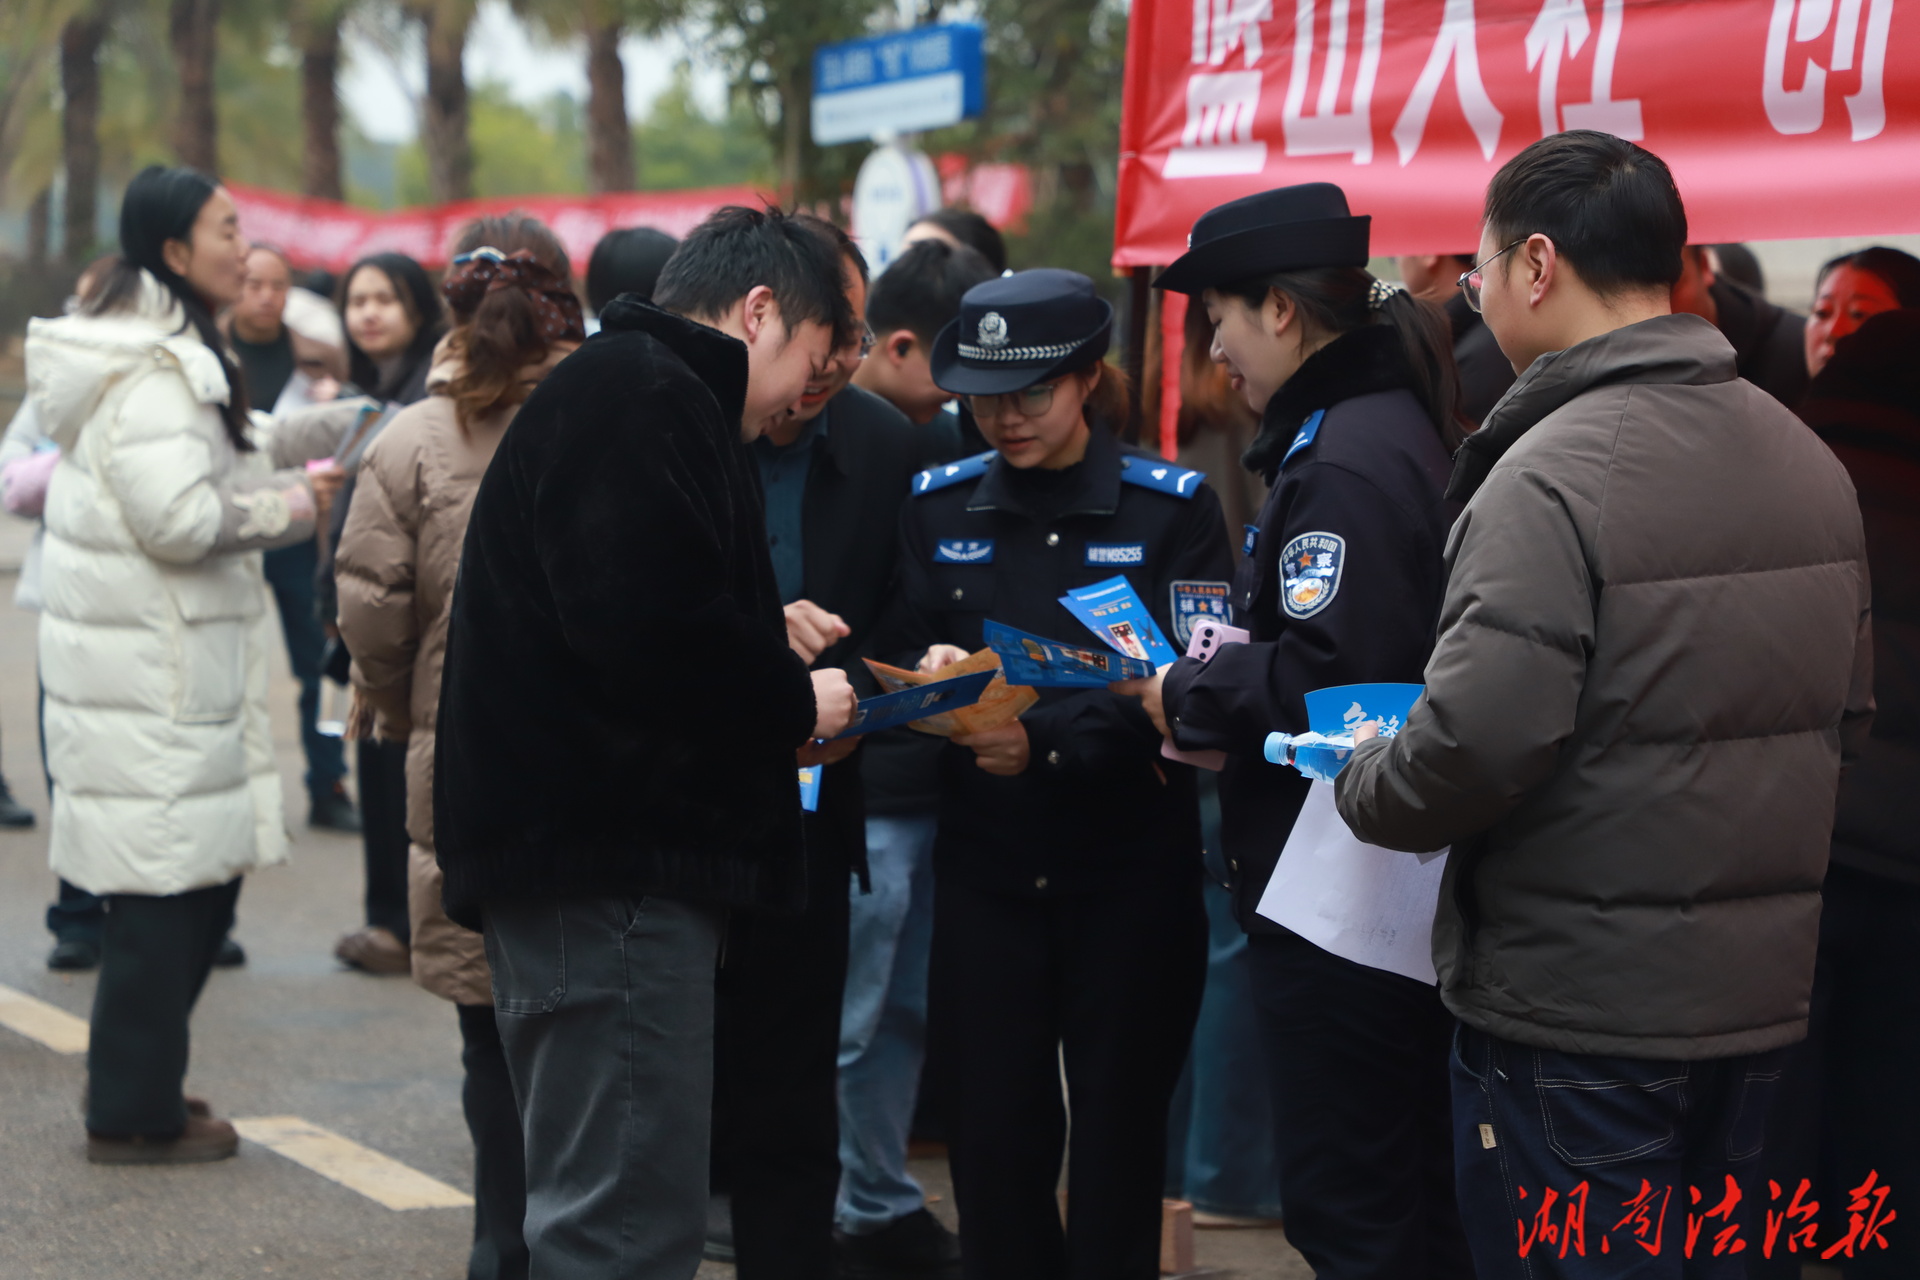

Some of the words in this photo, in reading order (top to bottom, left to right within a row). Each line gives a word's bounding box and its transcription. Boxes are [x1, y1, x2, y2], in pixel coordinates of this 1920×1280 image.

[1283, 536, 1338, 564] 中华人民共和国
